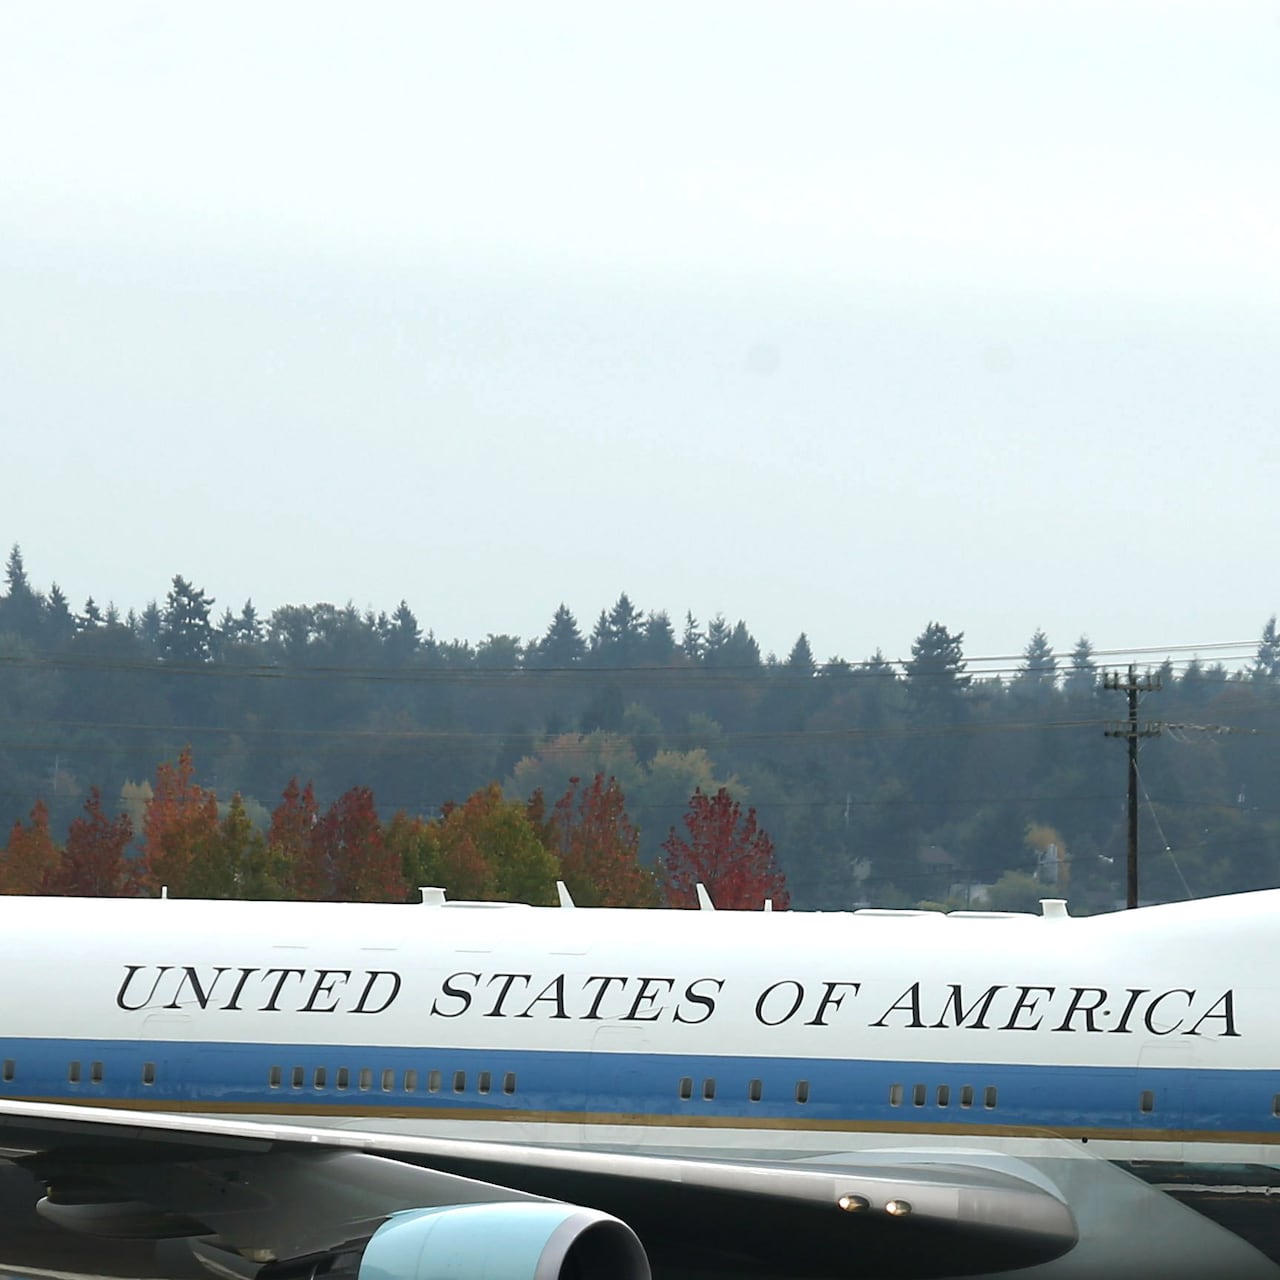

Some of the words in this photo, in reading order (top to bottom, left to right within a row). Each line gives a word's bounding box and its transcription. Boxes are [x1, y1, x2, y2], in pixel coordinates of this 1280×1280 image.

[115, 965, 402, 1015] UNITED
[430, 972, 726, 1024] STATES
[754, 980, 861, 1026] OF
[868, 981, 1242, 1037] AMERICA
